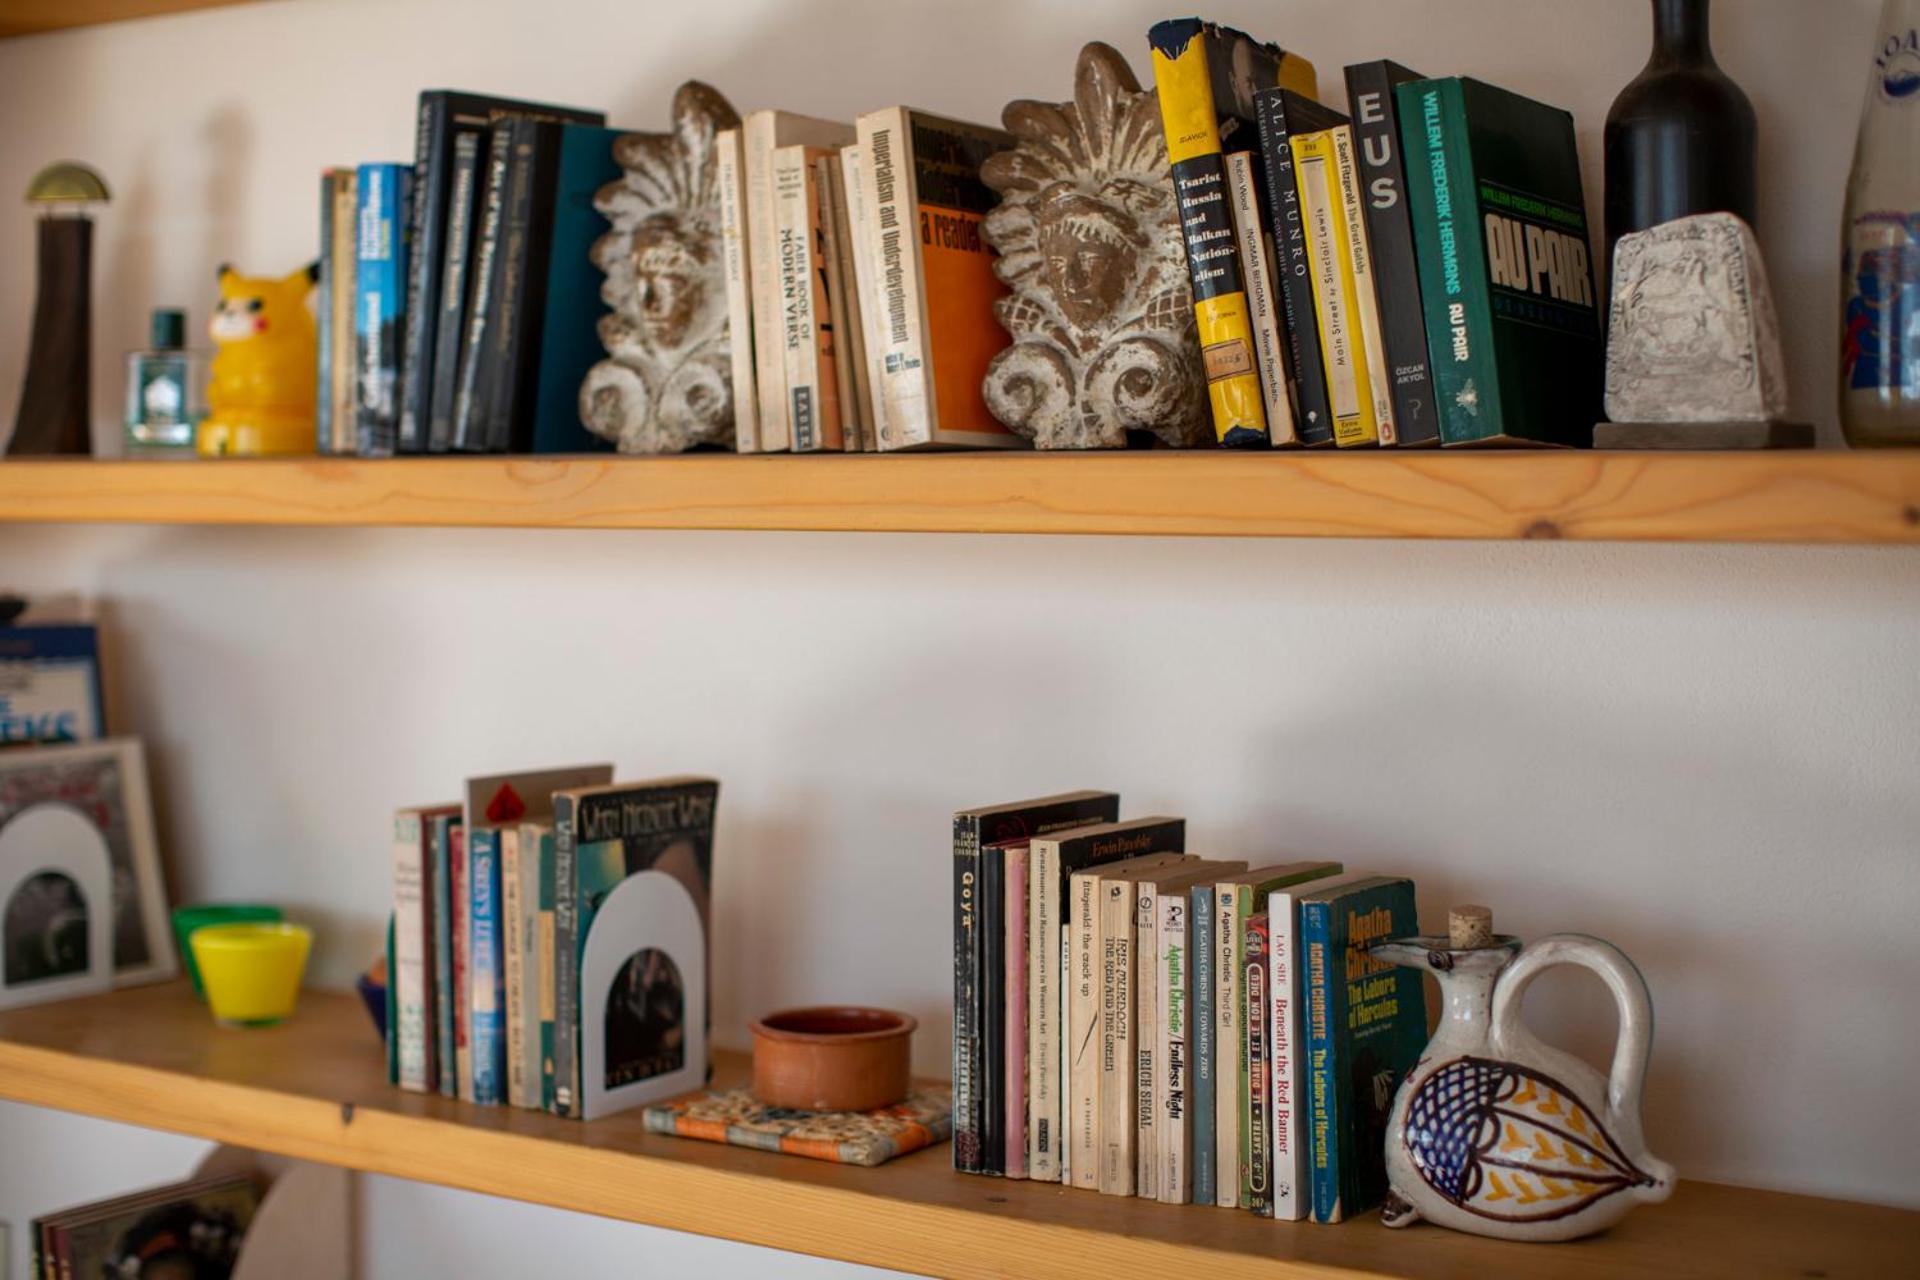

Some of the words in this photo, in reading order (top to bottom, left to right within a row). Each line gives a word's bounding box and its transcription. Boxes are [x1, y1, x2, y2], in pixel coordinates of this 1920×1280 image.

[1423, 91, 1442, 149] WILLEM
[872, 129, 895, 204] Imperialism
[1338, 141, 1350, 161] Scott
[1358, 93, 1399, 209] EUS
[1178, 172, 1221, 189] Tsarist
[1234, 158, 1246, 185] Robin
[1270, 96, 1288, 172] ALICE
[1283, 188, 1306, 278] MUNRO
[1341, 160, 1356, 205] Fitzgerald
[1431, 149, 1450, 220] FREDERIK
[1182, 191, 1222, 208] Russia
[1238, 187, 1249, 212] Wood
[879, 205, 897, 229] and
[921, 213, 932, 246] a
[1185, 212, 1206, 227] and
[1317, 207, 1330, 236] Lewis
[1350, 221, 1361, 245] Great
[1188, 228, 1231, 245] Balkan
[1246, 227, 1259, 275] INGMAR
[781, 229, 796, 298] MODERN
[795, 235, 806, 274] FABER
[1191, 247, 1235, 264] Nation-
[1322, 239, 1337, 285] Sinclair
[1440, 219, 1461, 294] HERMANS
[1485, 213, 1528, 291] AU
[1528, 224, 1593, 308] PAIR
[881, 229, 910, 344] Underdevelopment
[1194, 267, 1225, 283] alism
[798, 278, 809, 317] BOOK
[1251, 277, 1266, 318] BERGMAN
[1449, 304, 1463, 325] AU
[785, 302, 799, 352] VERSE
[1330, 301, 1343, 336] Street
[1336, 341, 1347, 366] Main
[1452, 326, 1469, 362] PAIR
[796, 389, 812, 449] FABER
[1092, 839, 1117, 857] Erwin
[1038, 847, 1047, 900] Renaissance
[961, 871, 975, 926] Goya
[1081, 880, 1092, 929] fitzgerald:
[1083, 933, 1092, 949] the
[1221, 911, 1230, 944] Agatha
[1347, 904, 1393, 946] Agatha
[1104, 937, 1114, 957] THE
[1116, 938, 1127, 966] IRIS
[1199, 928, 1208, 963] AGATHA
[1276, 934, 1285, 956] LAO
[1083, 952, 1092, 981] crack
[1104, 960, 1114, 982] RED
[1162, 944, 1183, 986] Agatha
[1222, 947, 1231, 982] Christie
[1277, 963, 1286, 985] SHE
[1309, 942, 1324, 984] AGATHA
[1081, 984, 1090, 997] up
[1104, 984, 1114, 1008] AND
[1199, 964, 1209, 1001] CHRISTIE
[1223, 987, 1231, 1008] Third
[1250, 974, 1261, 996] DIEU
[1347, 983, 1363, 1007] The
[1364, 975, 1396, 1001] Labors
[1039, 985, 1048, 1019] Western
[1116, 969, 1127, 1040] MURDOCH
[1169, 987, 1185, 1034] Christie
[1223, 1010, 1232, 1027] Girl
[1251, 1000, 1261, 1020] BON
[1311, 987, 1326, 1039] CHRISTIE
[1348, 1010, 1358, 1030] of
[1357, 998, 1399, 1029] Hercules
[1104, 1010, 1114, 1031] THE
[1199, 1011, 1209, 1054] TOWARDS
[1275, 998, 1287, 1050] Beneath
[1104, 1033, 1115, 1071] GREEN
[1139, 1049, 1151, 1088] ERICH
[1168, 1040, 1184, 1087] Endless
[1200, 1056, 1209, 1079] ZERO
[1276, 1054, 1287, 1075] the
[1313, 1048, 1326, 1068] The
[1252, 1057, 1262, 1087] DIABLE
[1314, 1069, 1328, 1106] Labors
[1165, 1088, 1184, 1120] Night
[1252, 1091, 1262, 1104] LE
[1277, 1079, 1289, 1103] Red
[1140, 1090, 1152, 1129] SEGAL
[1252, 1120, 1263, 1154] SARTRE
[1277, 1108, 1290, 1155] Banner
[1315, 1120, 1330, 1168] Hercules
